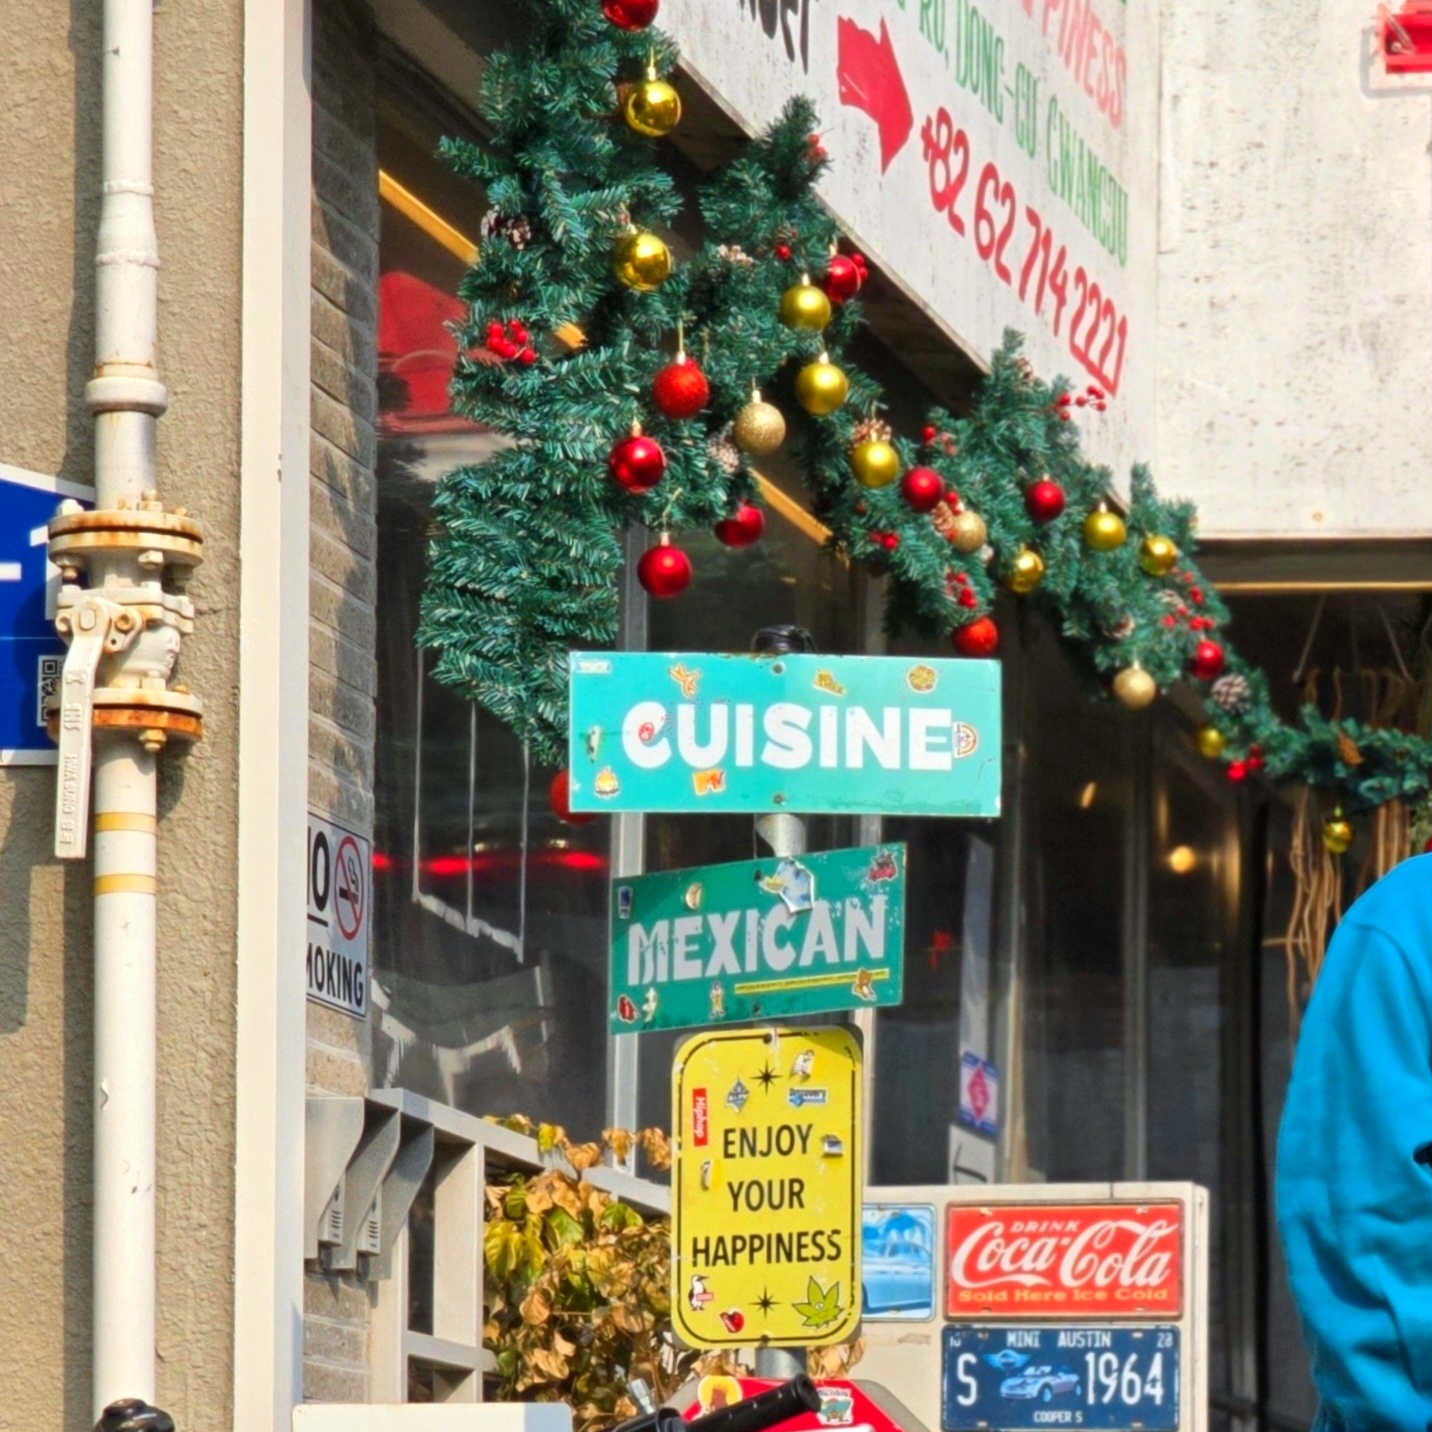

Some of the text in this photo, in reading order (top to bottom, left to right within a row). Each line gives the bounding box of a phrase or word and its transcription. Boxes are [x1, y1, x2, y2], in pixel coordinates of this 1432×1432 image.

[921, 106, 1128, 398] +82 62 714 2221
[621, 700, 953, 771] CUISINE
[627, 896, 888, 986] MEXICAN
[722, 1123, 814, 1159] ENJOY
[727, 1178, 805, 1212] YOUR
[1010, 1220, 1081, 1233] DRINK
[692, 1229, 842, 1268] HAPPINESS
[951, 1219, 1179, 1289] Coca-Cola
[958, 1287, 1168, 1303] Sold Here Ice Cold
[1006, 1330, 1041, 1348] MINI
[1057, 1330, 1112, 1348] AUSTIN
[956, 1351, 1165, 1406] S 1964
[1033, 1411, 1084, 1423] COOPER S
